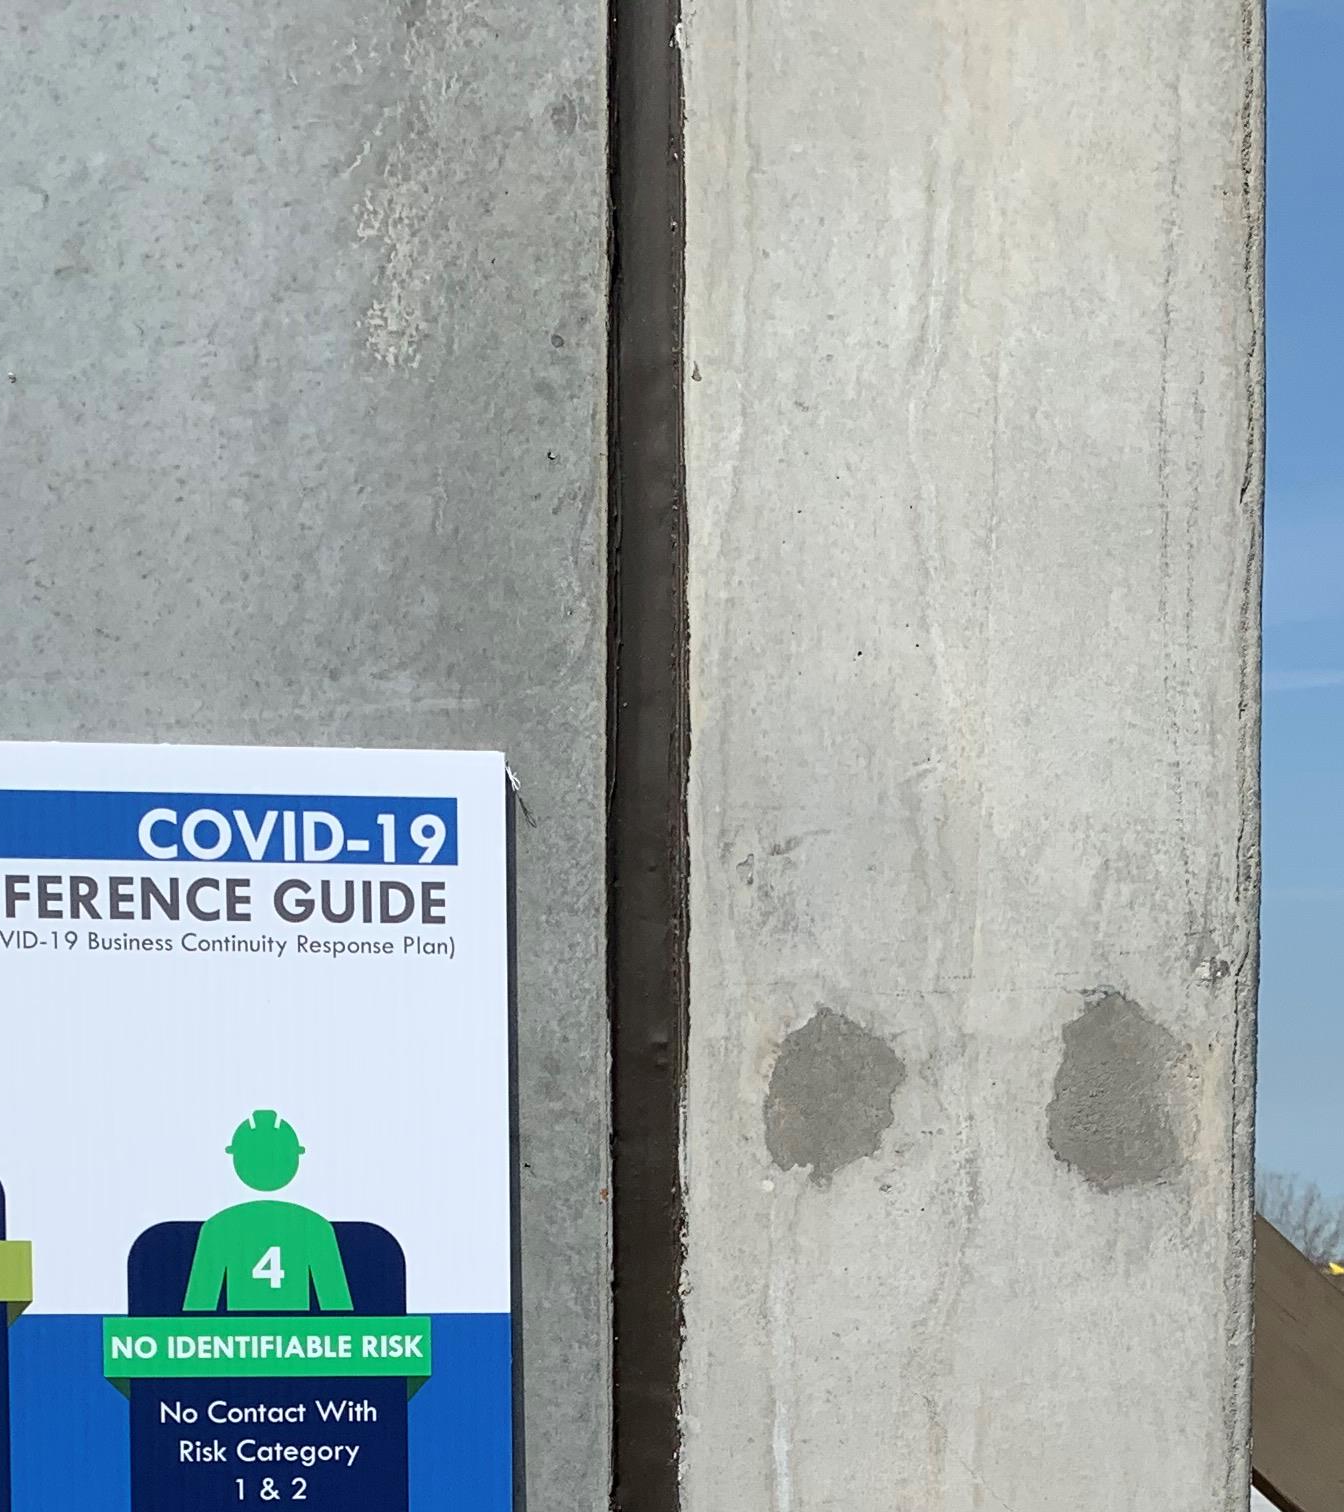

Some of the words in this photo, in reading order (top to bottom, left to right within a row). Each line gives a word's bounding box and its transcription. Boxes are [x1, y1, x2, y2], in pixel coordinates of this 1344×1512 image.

[136, 806, 448, 866] COVID-19
[273, 878, 446, 925] GUIDE
[88, 931, 173, 952] Business
[181, 932, 288, 958] Continuity
[297, 934, 394, 959] Response
[403, 935, 455, 960] Plan)
[251, 1246, 285, 1289] 4
[111, 1335, 158, 1359] NO
[167, 1335, 352, 1359] IDENTIFIABLE
[362, 1334, 424, 1358] RISK
[160, 1401, 198, 1424] No
[207, 1400, 307, 1424] Contact
[315, 1399, 377, 1422] With
[179, 1439, 227, 1462] Risk
[236, 1439, 360, 1467] Category
[235, 1478, 244, 1500] 1
[260, 1477, 281, 1501] &
[291, 1477, 307, 1500] 2
